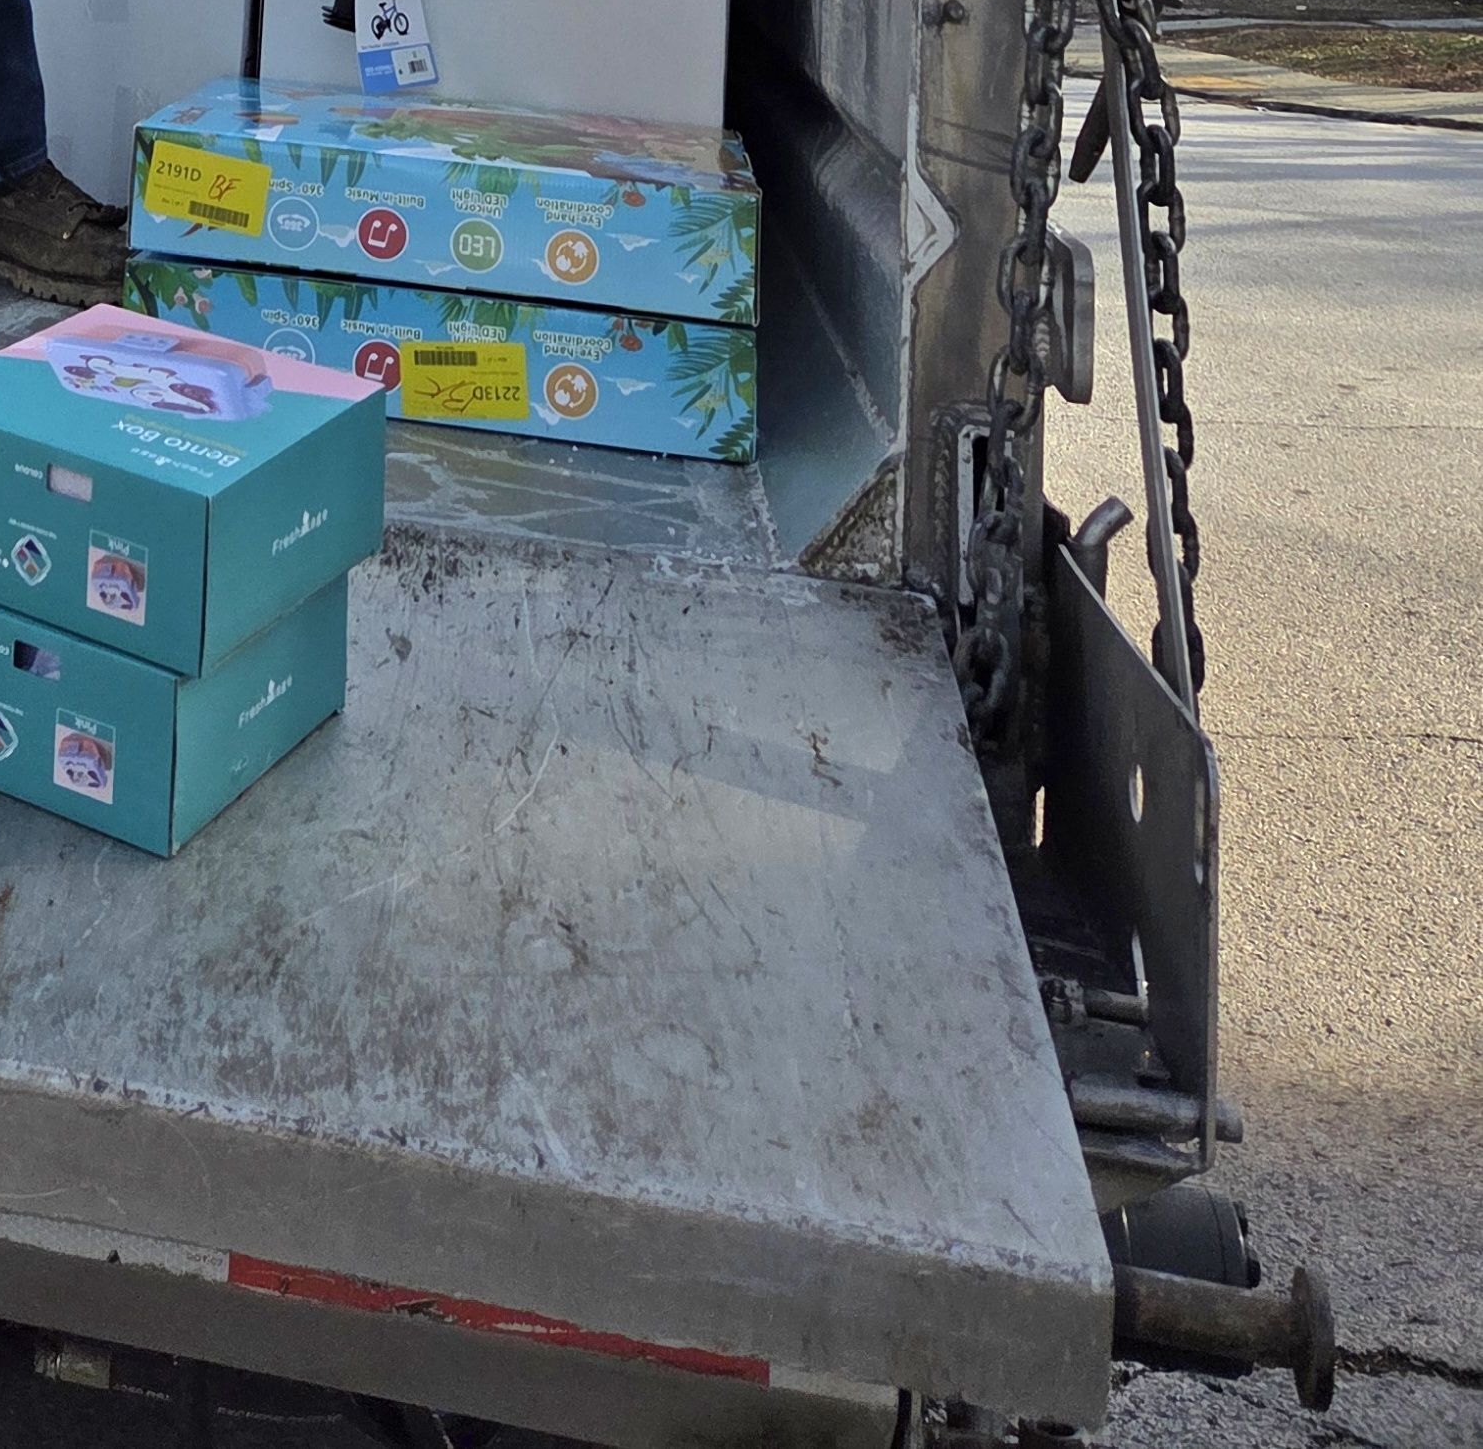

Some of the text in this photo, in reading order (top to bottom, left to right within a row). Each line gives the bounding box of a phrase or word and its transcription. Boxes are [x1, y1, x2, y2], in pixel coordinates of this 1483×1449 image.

[156, 160, 202, 182] 2191D
[269, 179, 294, 192] Spin
[347, 187, 425, 208] Built-in Music
[451, 188, 508, 207] LED Light
[455, 201, 502, 218] Unicorn
[536, 197, 614, 219] Coordination
[545, 210, 602, 229] Eye-hand
[458, 233, 496, 258] LED
[261, 310, 289, 323] Spin
[342, 320, 423, 341] Built-in Music
[448, 321, 506, 339] LED Light
[534, 331, 612, 352] Coordination
[473, 385, 521, 401] 2213D
[111, 420, 161, 443] Box
[164, 437, 240, 467] Bento
[108, 536, 130, 556] Pink
[75, 716, 98, 736] Pink
